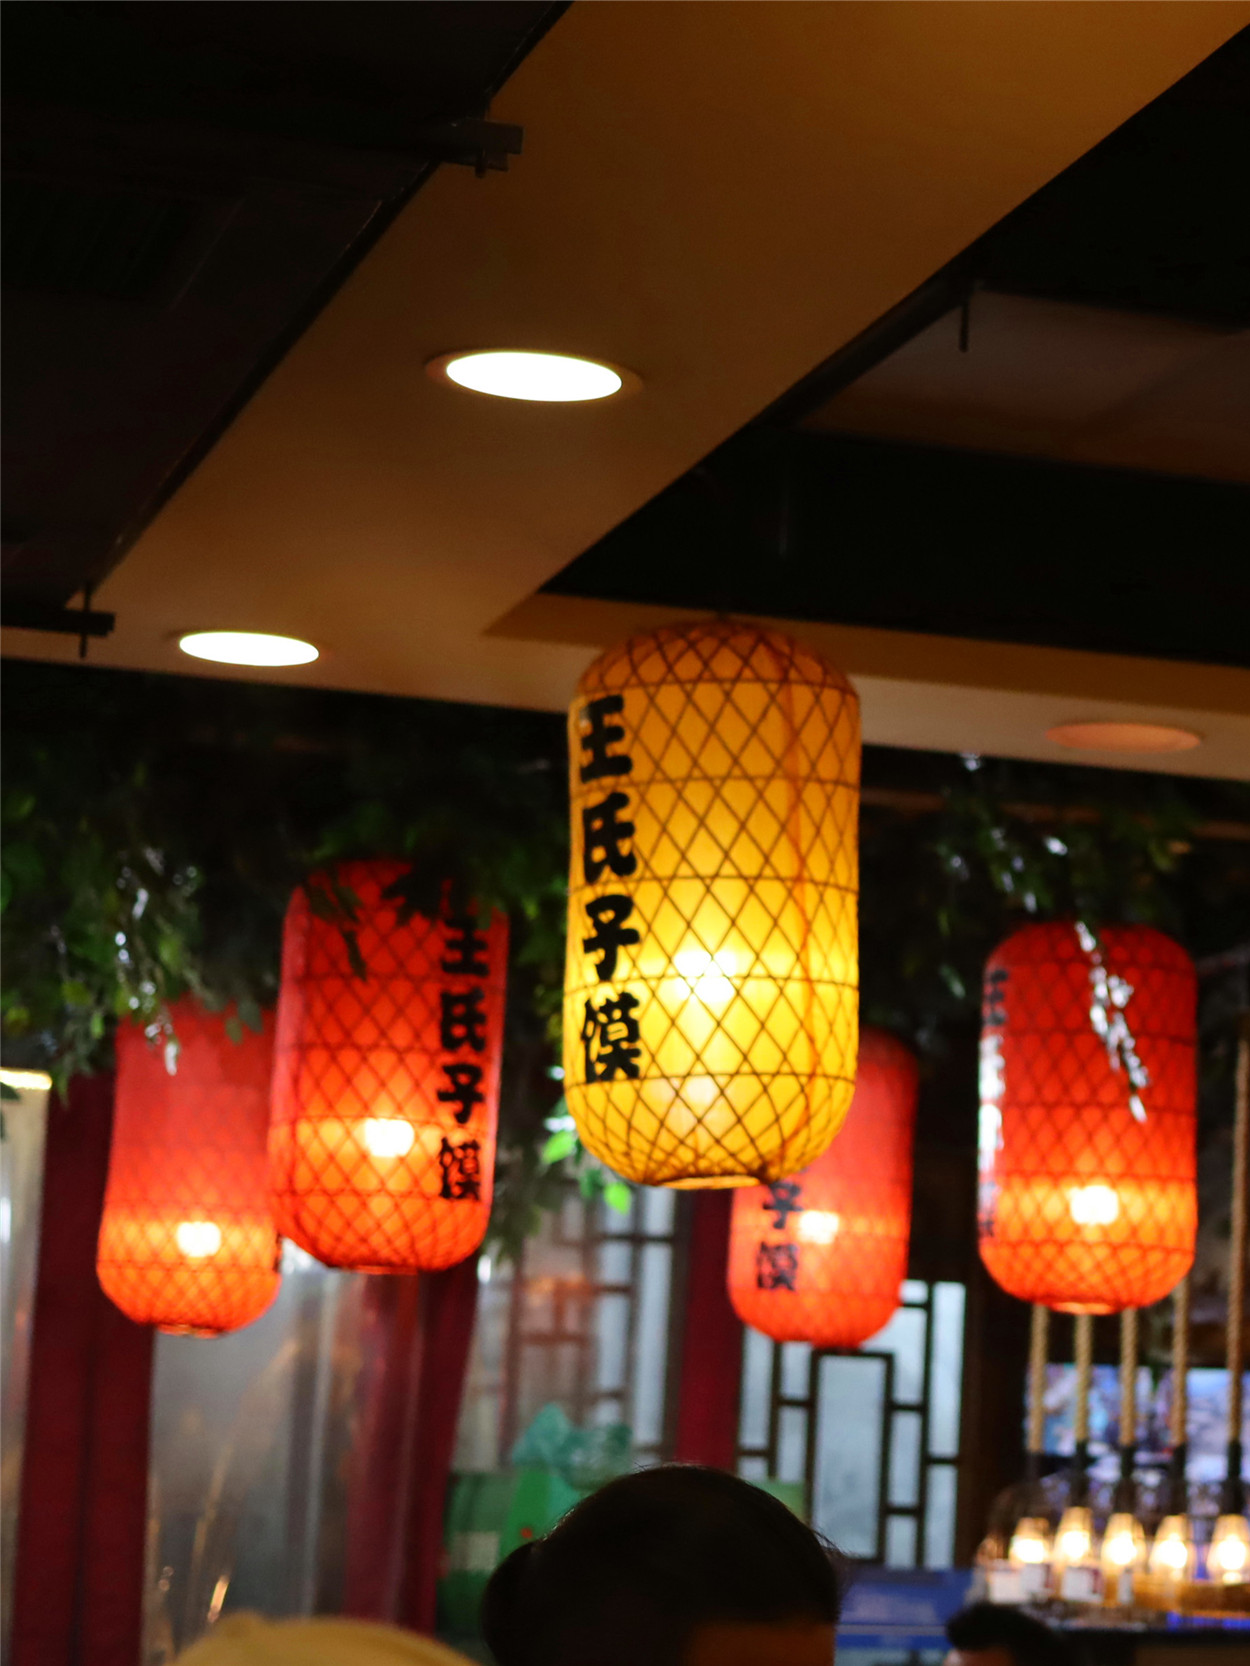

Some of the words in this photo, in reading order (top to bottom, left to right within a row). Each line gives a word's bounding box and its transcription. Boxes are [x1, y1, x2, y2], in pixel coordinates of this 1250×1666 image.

[437, 908, 490, 1200] 王氏子馍
[579, 695, 640, 1082] 王氏子馍
